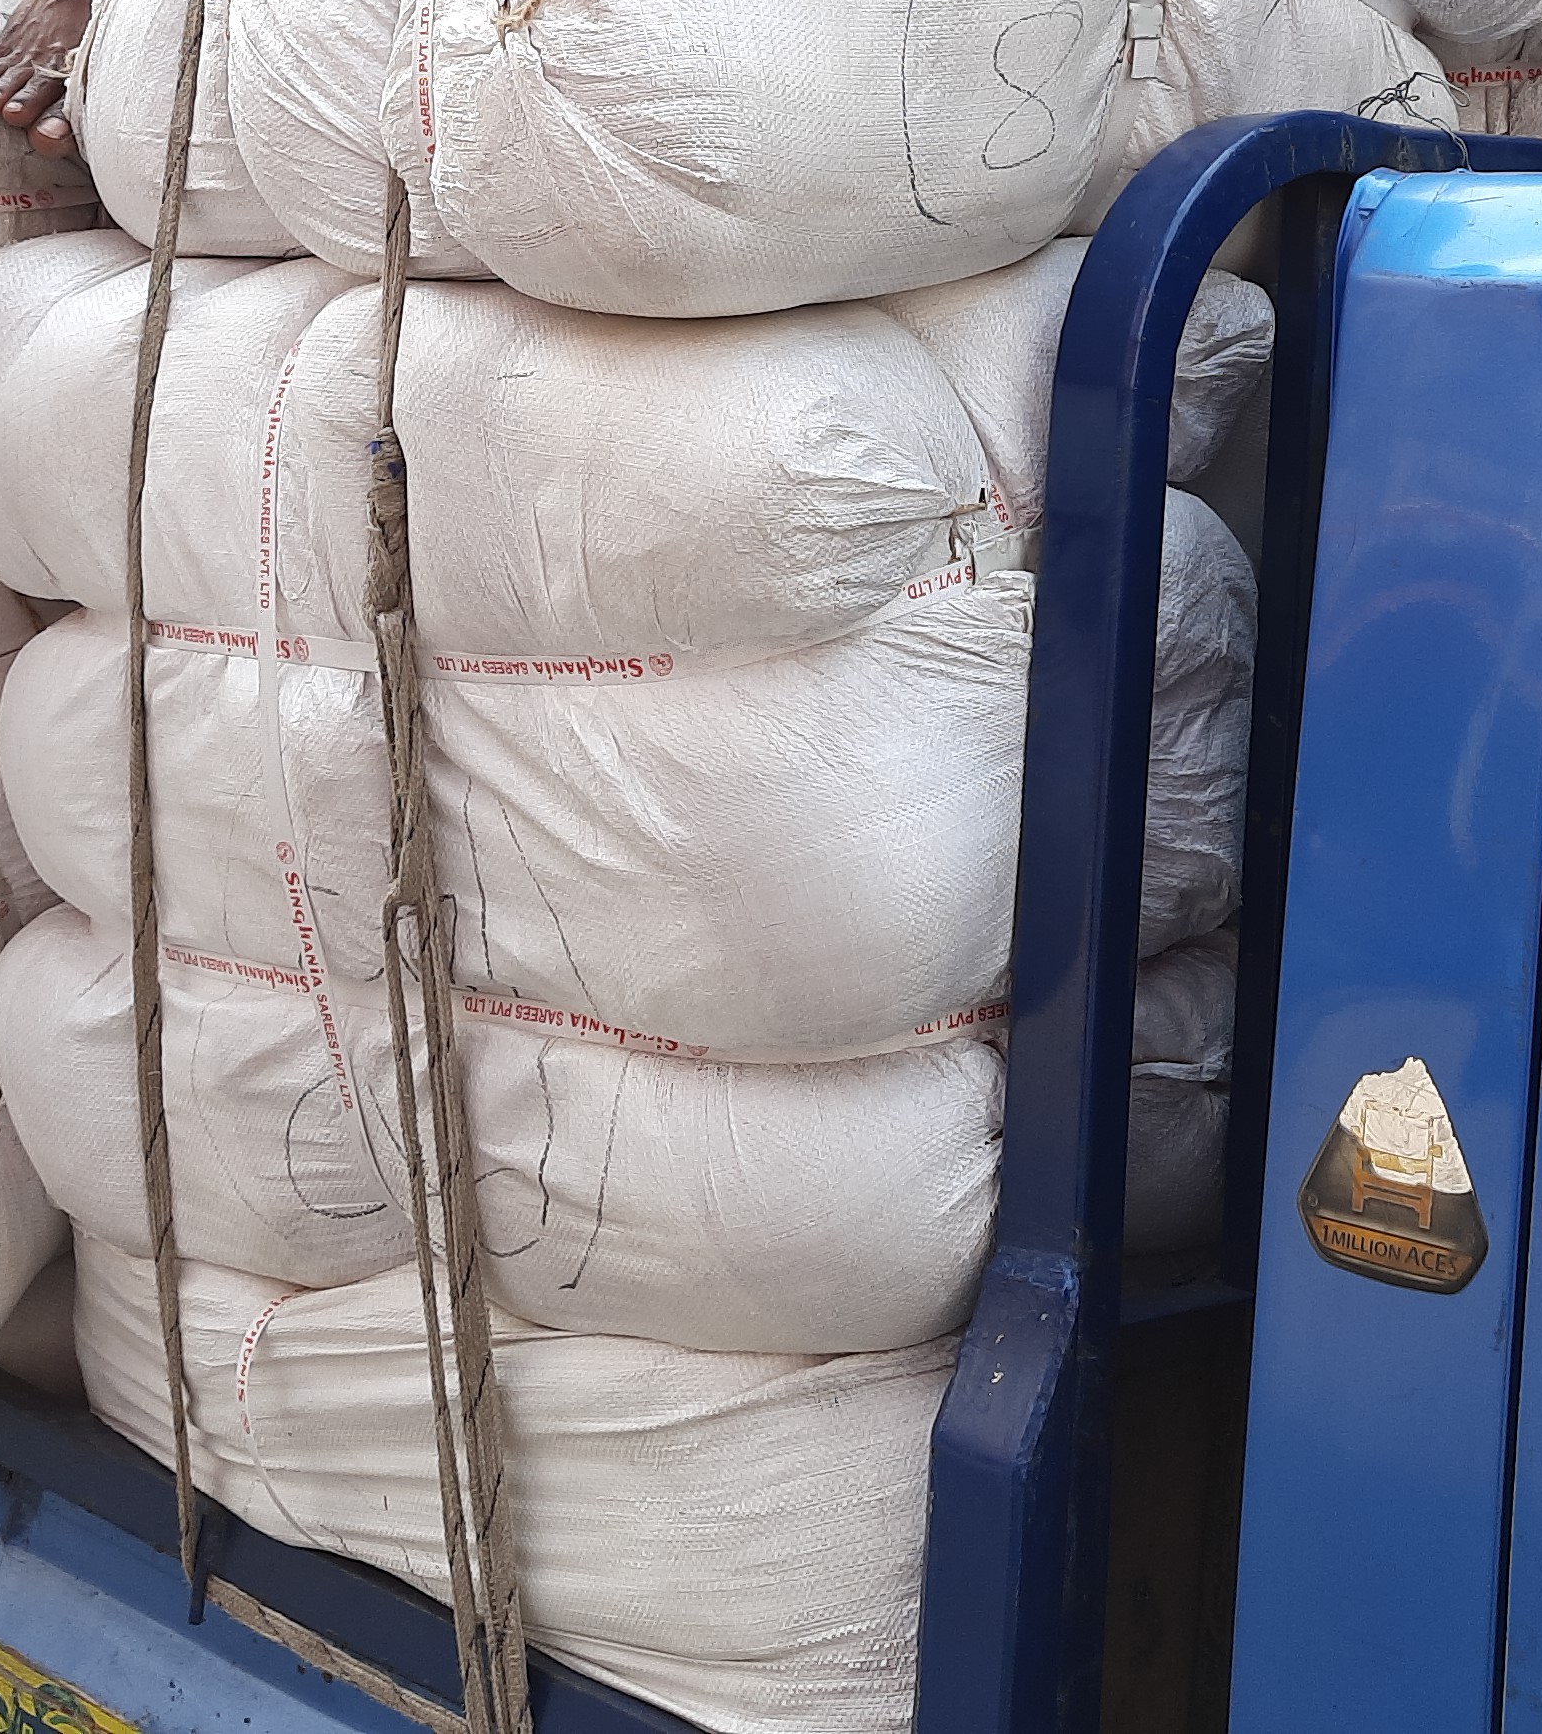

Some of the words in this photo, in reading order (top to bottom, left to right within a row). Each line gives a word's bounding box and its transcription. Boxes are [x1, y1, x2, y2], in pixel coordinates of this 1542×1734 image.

[418, 77, 434, 138] SAREES
[483, 660, 532, 676] SAREES
[316, 993, 340, 1050] SAREES
[515, 1002, 564, 1027] SAREES
[1330, 1228, 1402, 1264] MILLION
[1403, 1246, 1458, 1276] ACES
